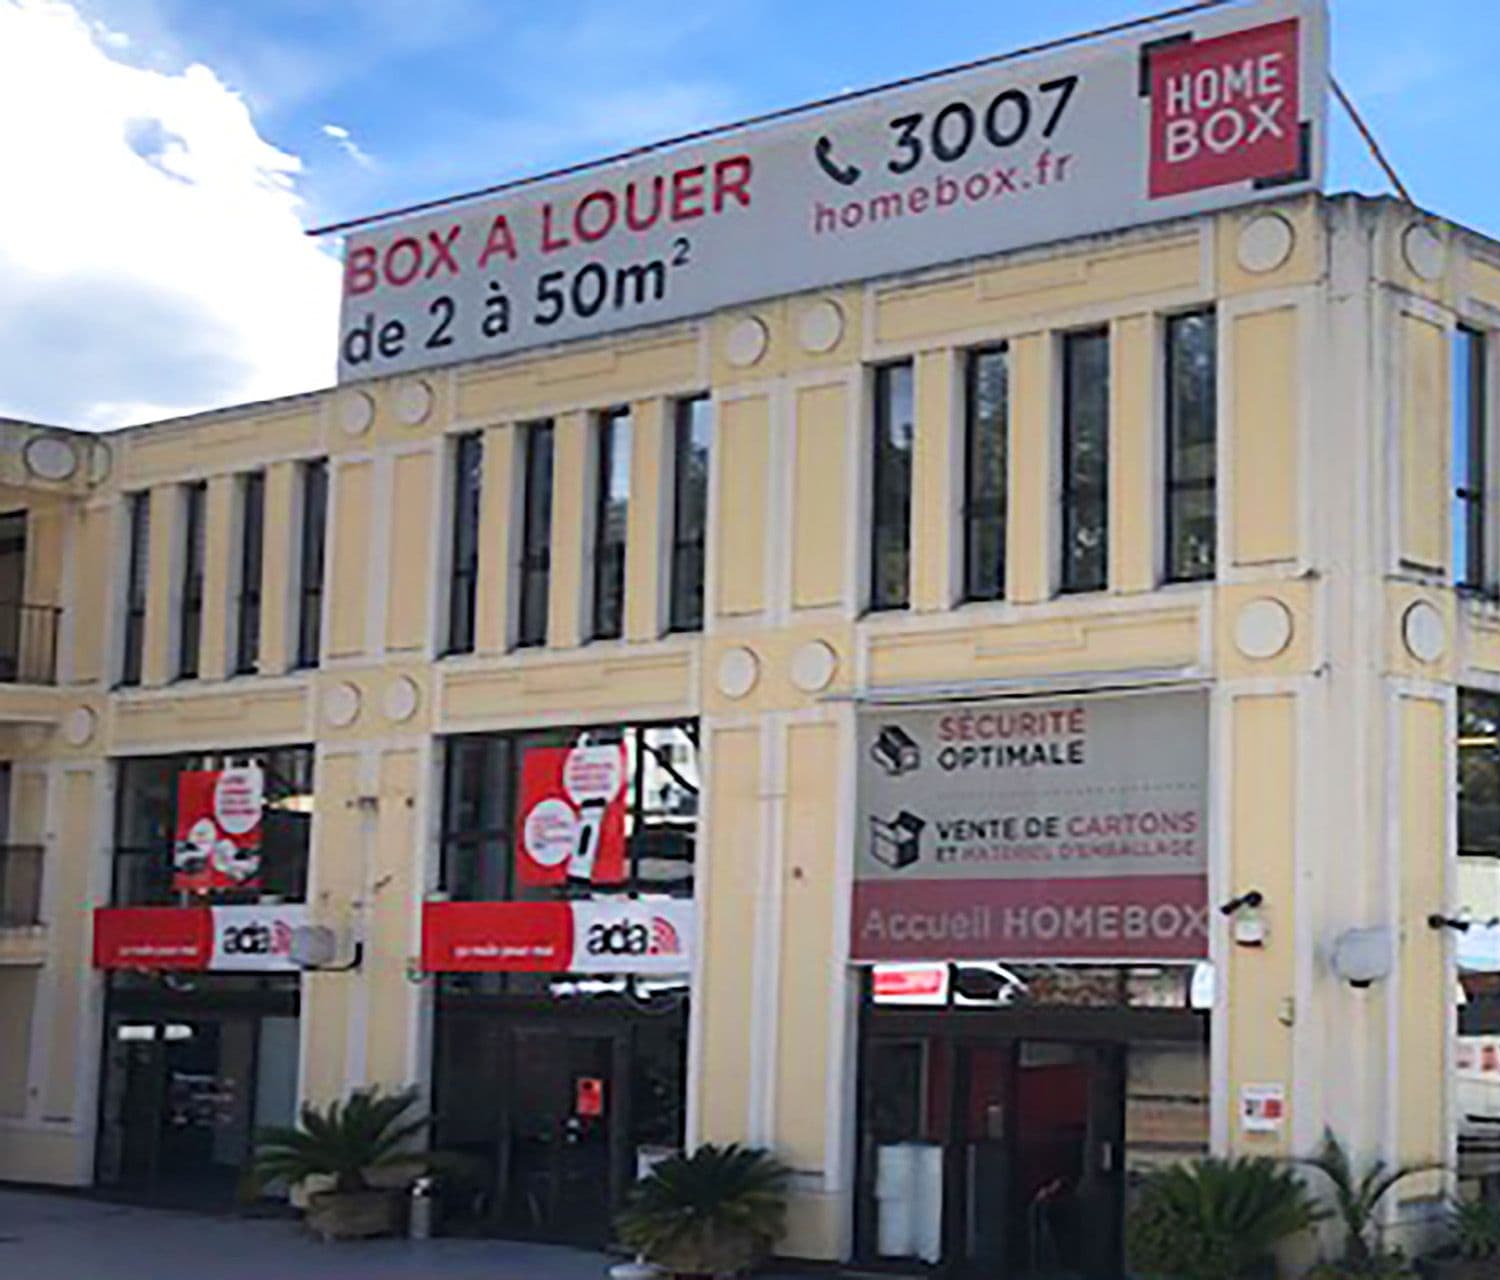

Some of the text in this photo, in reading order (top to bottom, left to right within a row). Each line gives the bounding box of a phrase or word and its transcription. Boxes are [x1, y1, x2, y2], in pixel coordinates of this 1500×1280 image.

[1166, 52, 1283, 116] HOME
[887, 75, 1078, 174] 3007
[1166, 98, 1284, 163] BOX
[814, 149, 1072, 234] homebox.fr
[346, 154, 752, 295] BOX A LOUER
[343, 314, 405, 365] de
[425, 296, 455, 349] 2
[482, 282, 510, 337] à
[938, 704, 1085, 742] SÉCURITÉ
[937, 740, 1085, 771] OPTIMALE
[935, 811, 1198, 841] VENTE DE CARTONS
[936, 846, 957, 862] ET
[222, 920, 270, 955] ada
[586, 917, 649, 955] ada
[863, 904, 1209, 941] Accueil HOMEBOX
